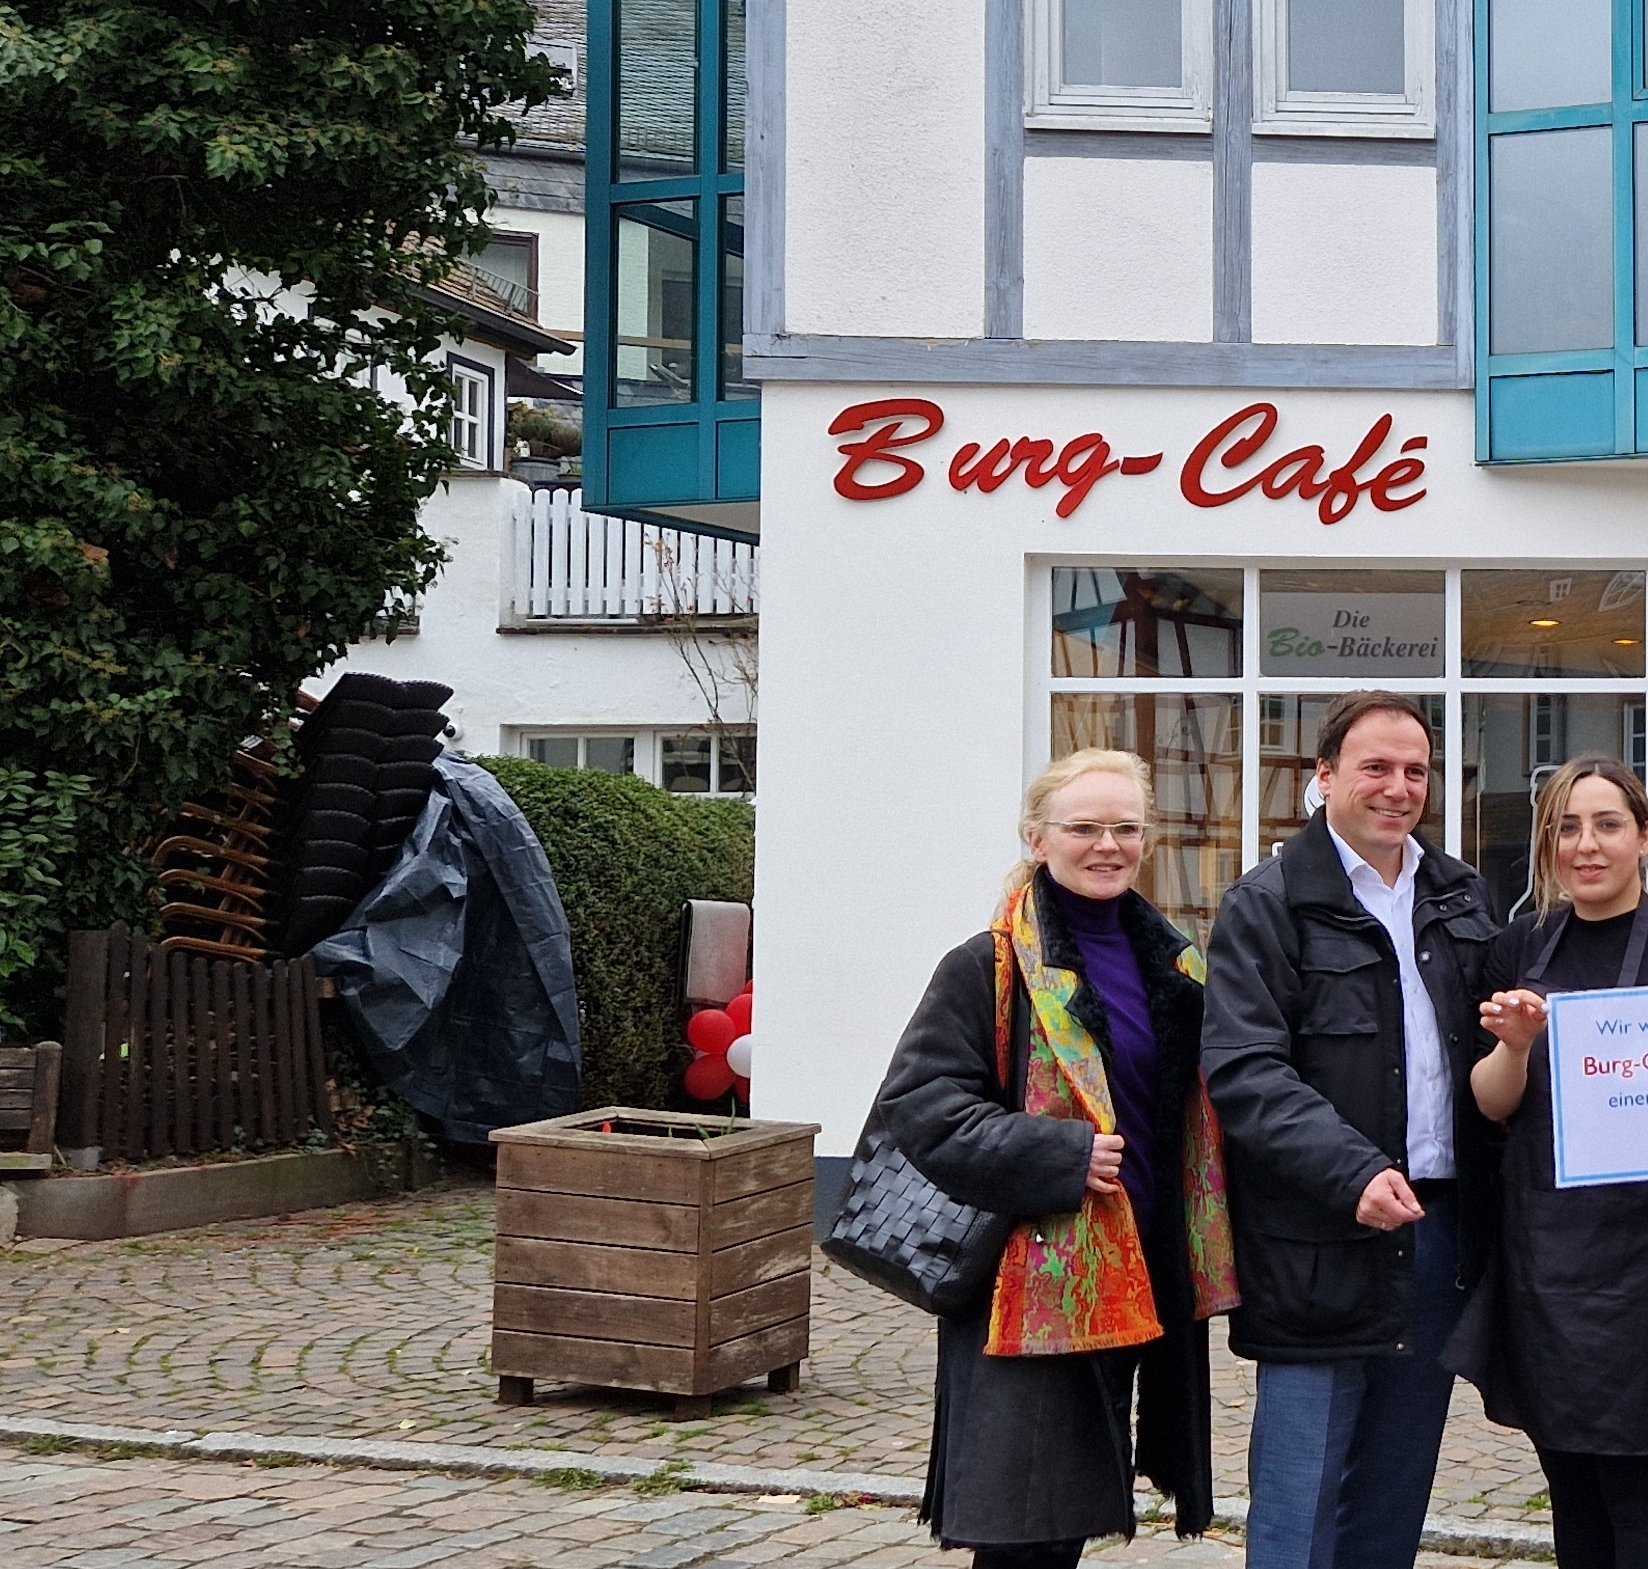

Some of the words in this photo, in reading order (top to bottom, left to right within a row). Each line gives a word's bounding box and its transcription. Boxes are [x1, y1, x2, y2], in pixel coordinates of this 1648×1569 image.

[1332, 610, 1371, 628] Die
[1267, 626, 1440, 658] Bio-Bäckerei
[1595, 1019, 1632, 1036] Wir
